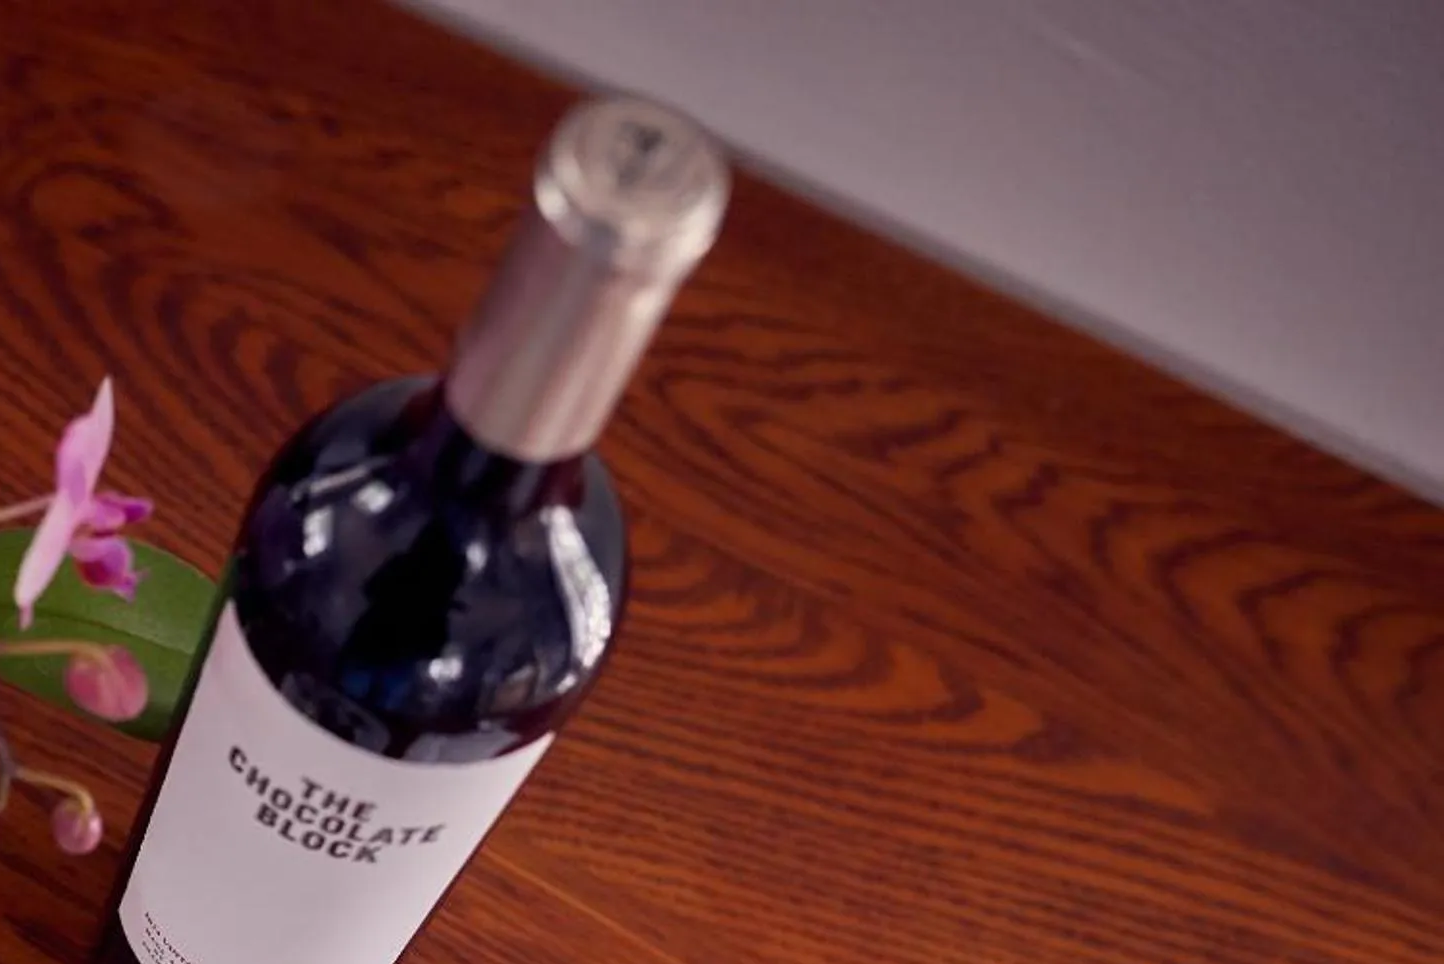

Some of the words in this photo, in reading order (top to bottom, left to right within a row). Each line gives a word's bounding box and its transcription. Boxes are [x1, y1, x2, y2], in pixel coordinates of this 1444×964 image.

[228, 745, 446, 844] CHOCOLATE
[302, 776, 378, 822] THE
[255, 803, 381, 863] BLOCK
